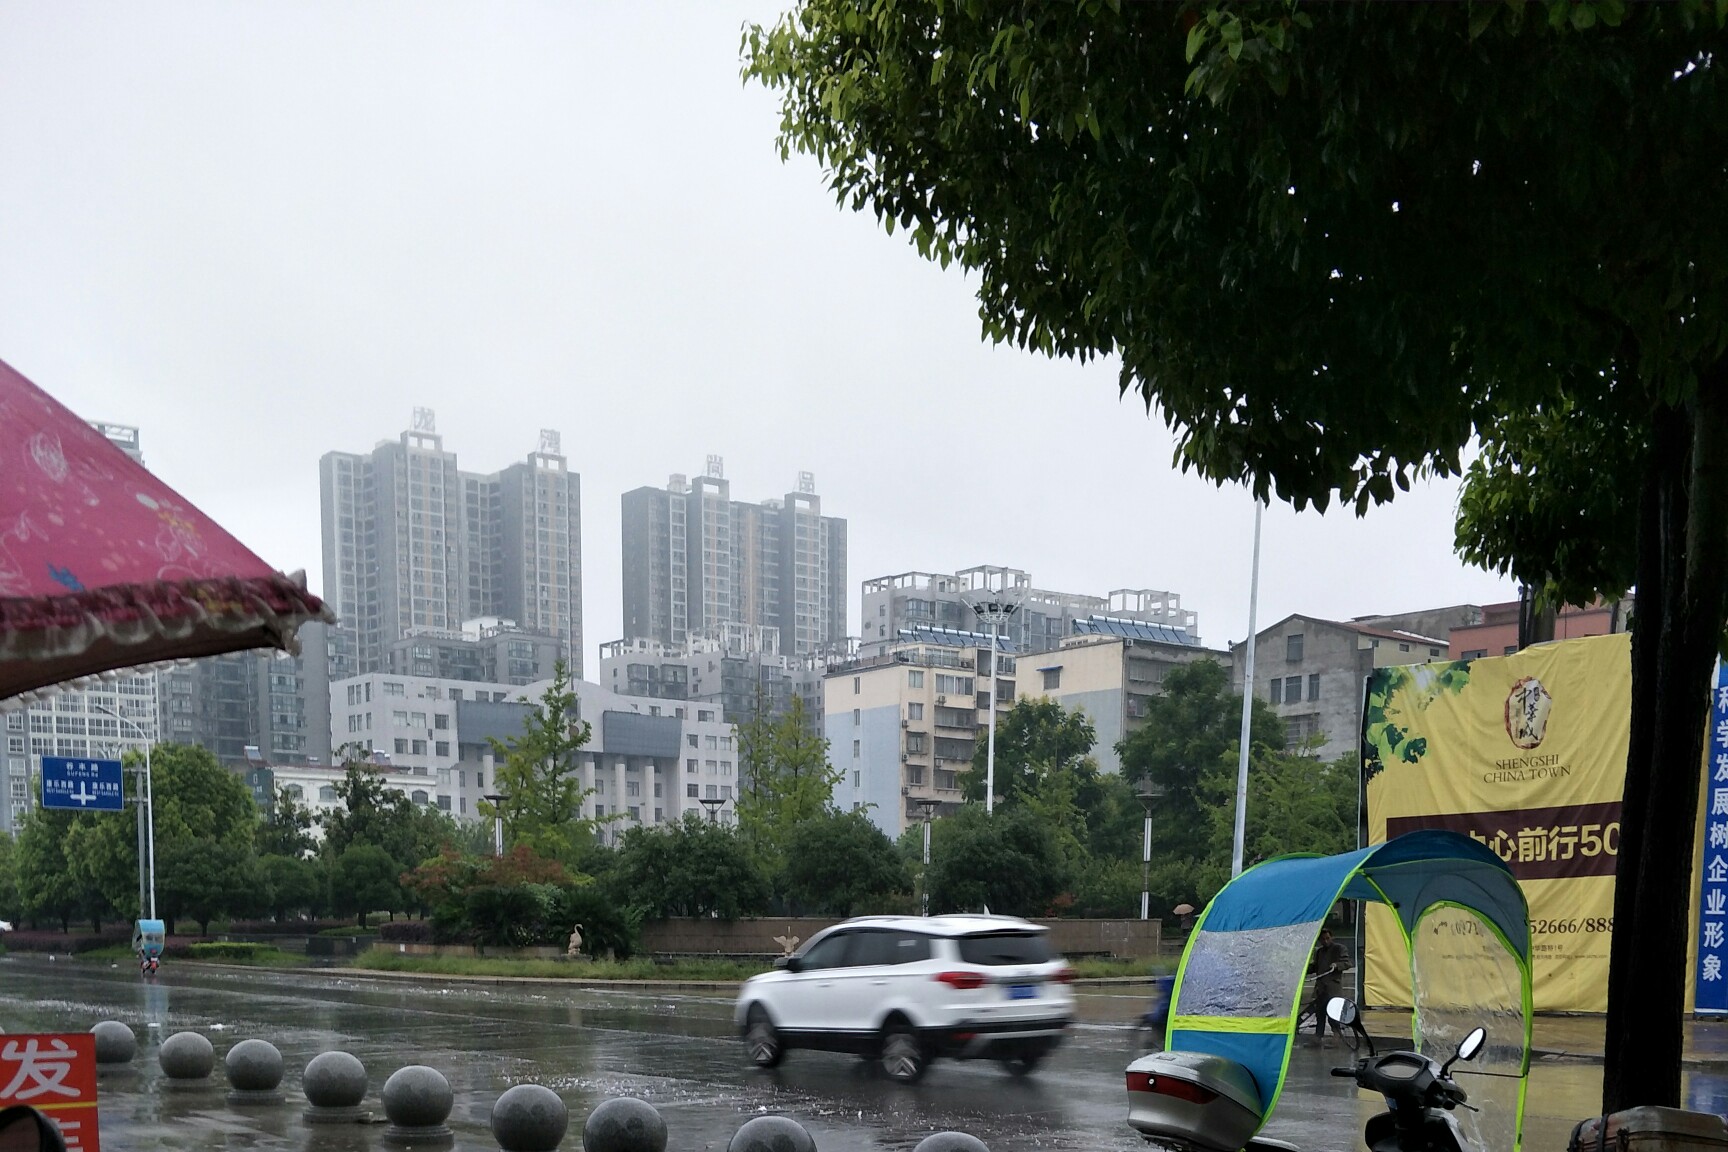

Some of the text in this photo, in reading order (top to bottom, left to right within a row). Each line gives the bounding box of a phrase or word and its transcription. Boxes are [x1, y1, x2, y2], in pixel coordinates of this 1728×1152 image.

[1495, 753, 1559, 770] SHENGSHI
[1483, 764, 1571, 784] CHINA TOWN
